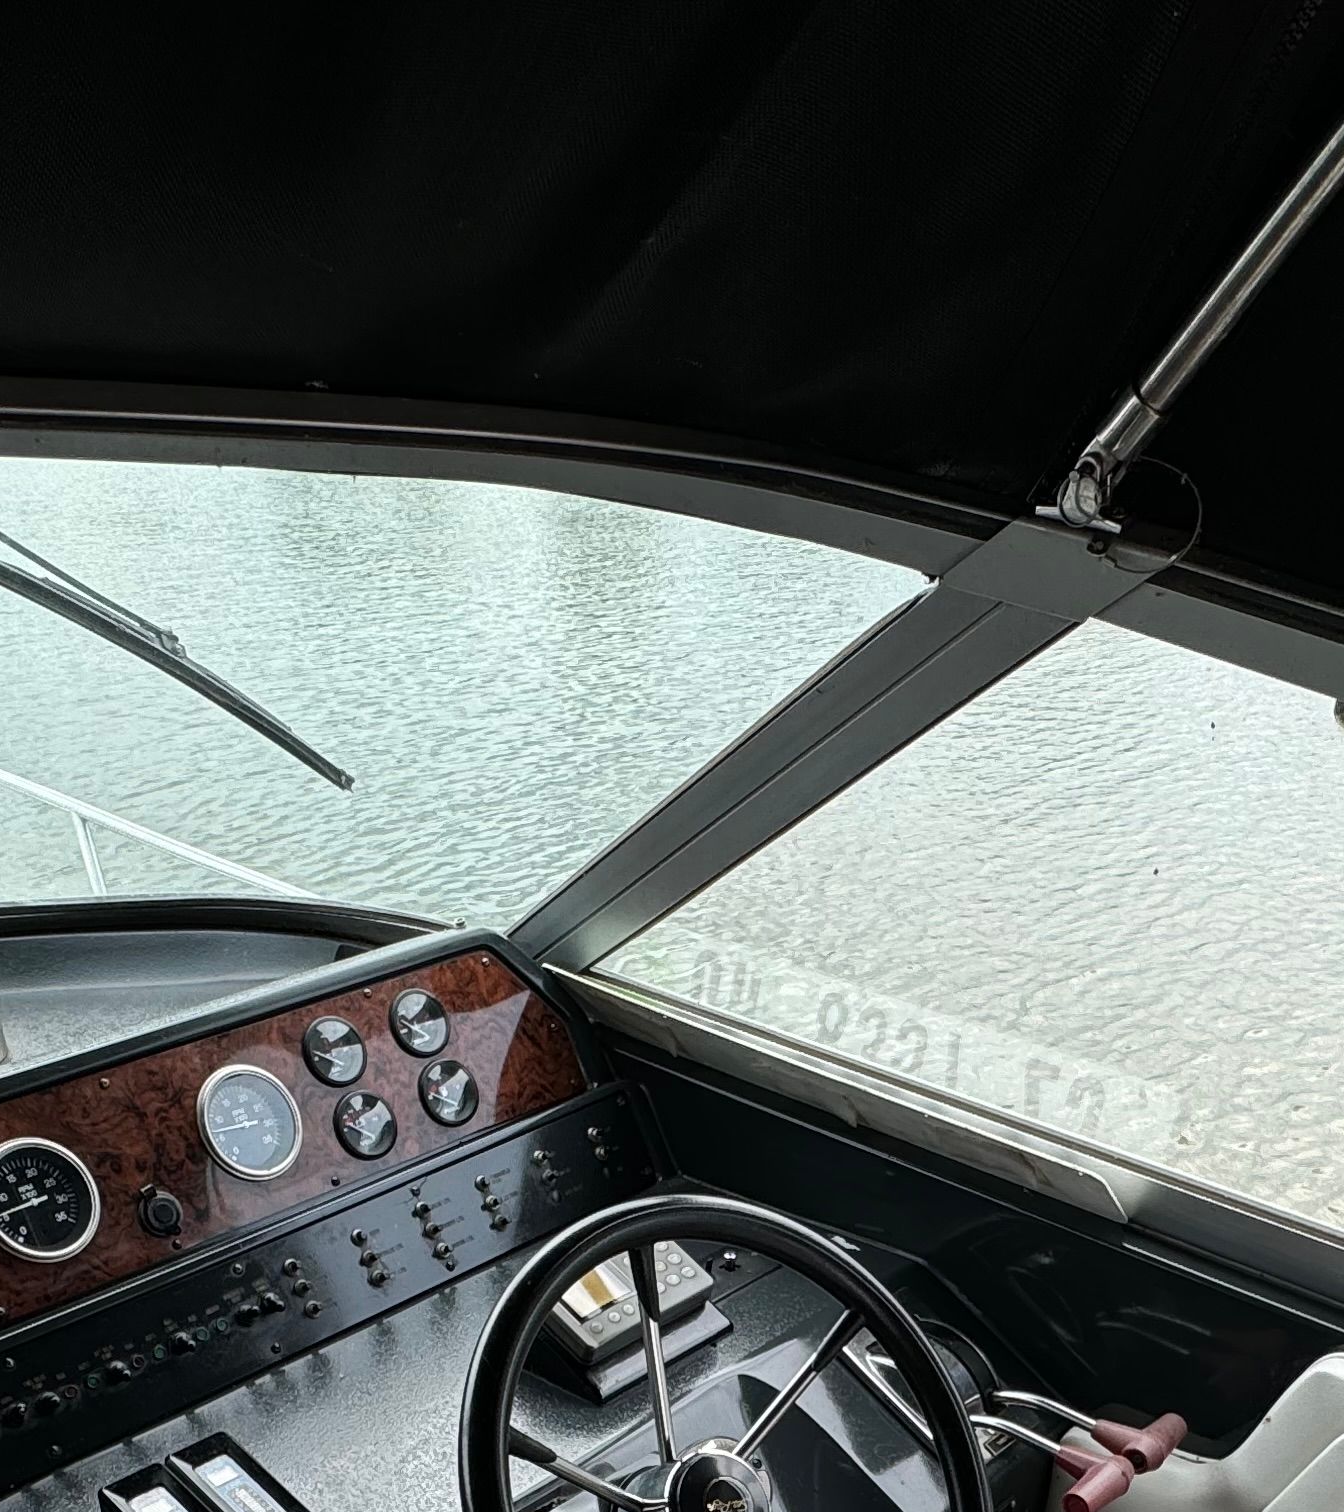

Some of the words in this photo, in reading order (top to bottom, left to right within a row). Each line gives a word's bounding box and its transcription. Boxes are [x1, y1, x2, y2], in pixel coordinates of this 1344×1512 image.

[25, 1167, 38, 1178] 20
[5, 1174, 17, 1183] 15
[43, 1177, 57, 1188] 25
[18, 1183, 34, 1193] RPM
[56, 1193, 68, 1204] 30
[54, 1211, 67, 1222] 35
[19, 1226, 27, 1235] 0
